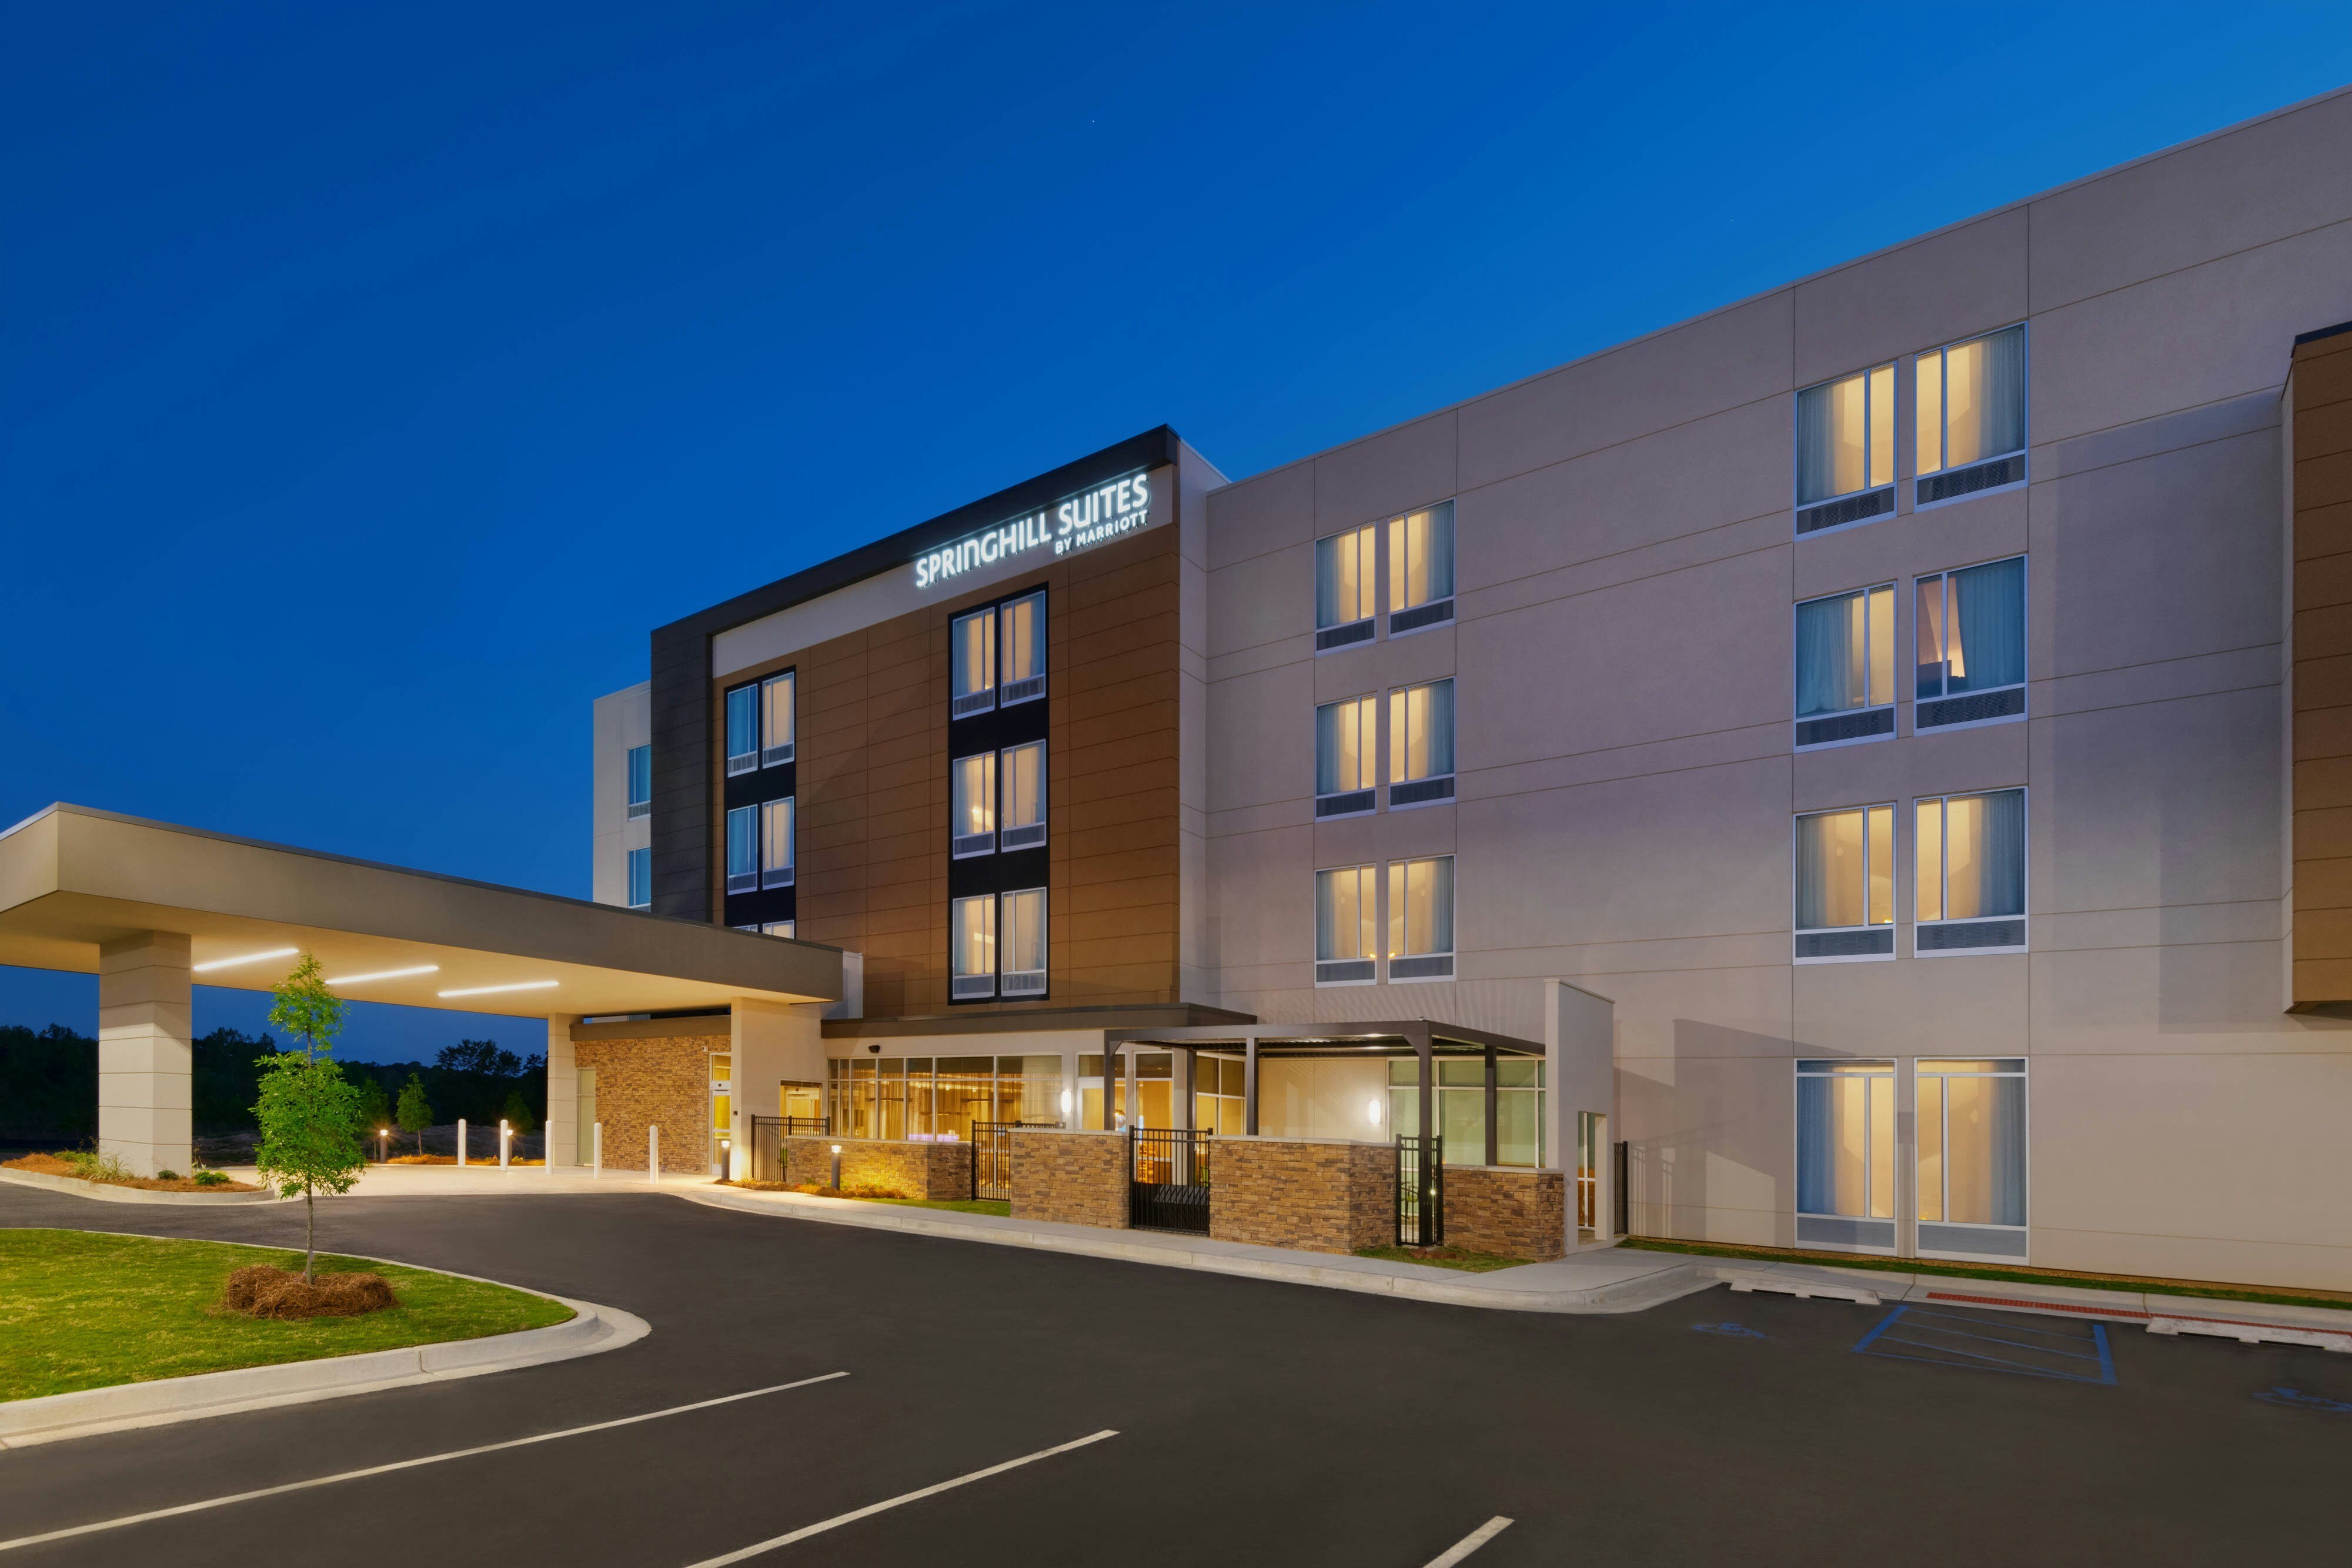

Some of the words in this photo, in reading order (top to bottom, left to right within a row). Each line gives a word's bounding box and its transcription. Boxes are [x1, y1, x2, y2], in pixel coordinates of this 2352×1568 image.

[1058, 474, 1149, 534] SUITES
[1055, 536, 1072, 554] BY
[1076, 509, 1148, 547] MARRIOTT
